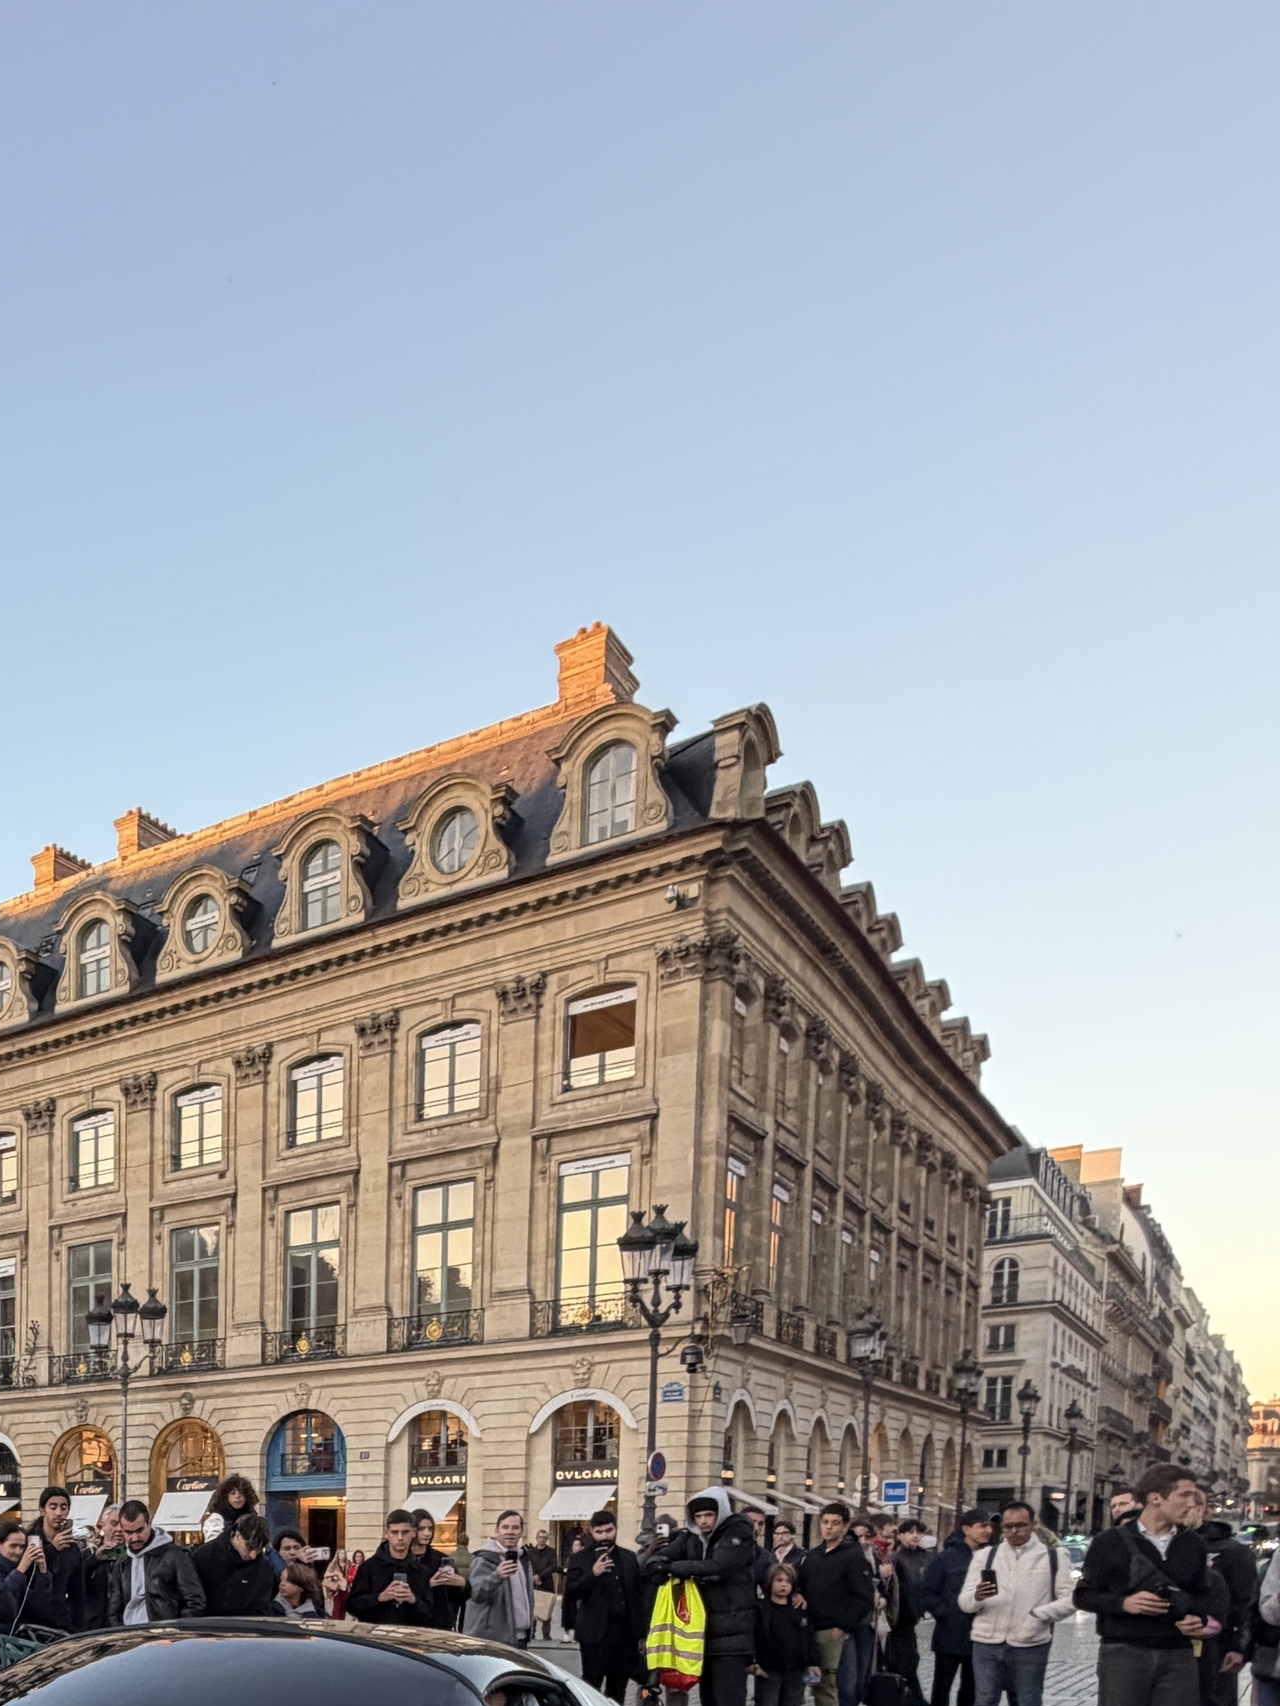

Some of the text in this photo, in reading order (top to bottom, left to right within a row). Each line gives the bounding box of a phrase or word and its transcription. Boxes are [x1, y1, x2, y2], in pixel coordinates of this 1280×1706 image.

[410, 1475, 466, 1485] BVLGARI
[555, 1469, 618, 1480] BVLGARI
[73, 1482, 104, 1495] Cartier
[176, 1479, 209, 1491] Cartier
